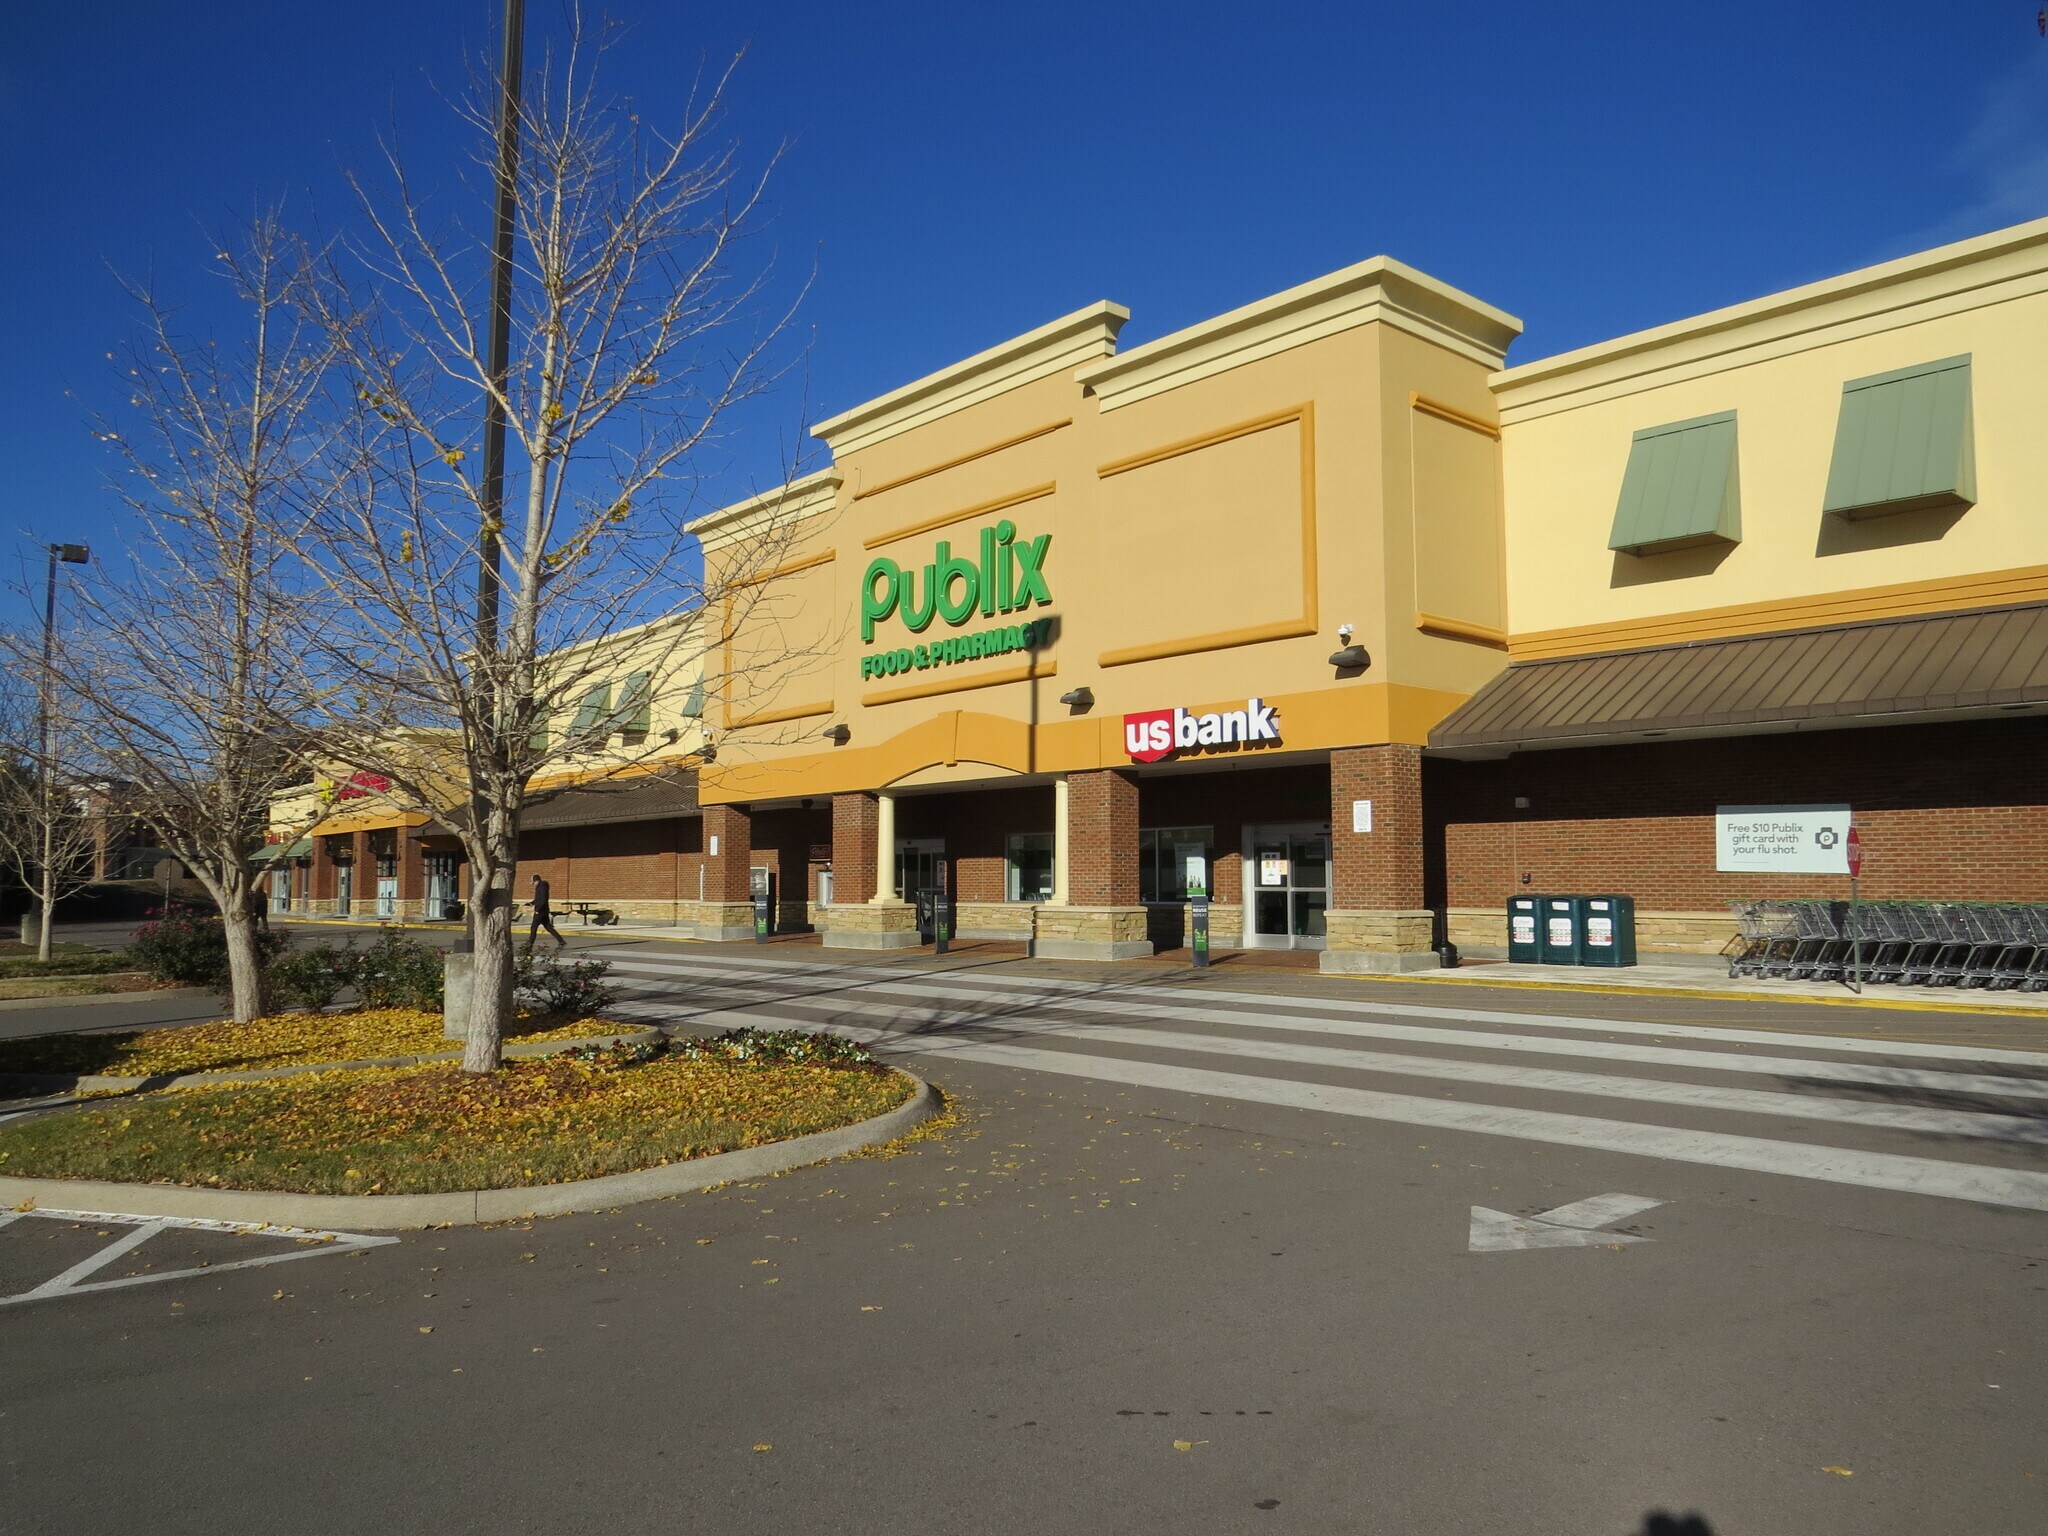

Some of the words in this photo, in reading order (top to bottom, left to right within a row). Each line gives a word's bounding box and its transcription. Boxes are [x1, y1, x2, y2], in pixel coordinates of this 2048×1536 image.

[861, 648, 914, 679] FOOD
[913, 645, 931, 668] &
[930, 619, 1053, 665] PHARMACY
[1727, 823, 1750, 833] Free
[1752, 822, 1770, 833] $10
[1771, 822, 1804, 833] Publix
[1732, 833, 1751, 846] gift
[1752, 833, 1775, 843] card
[1776, 833, 1799, 843] with
[1732, 846, 1756, 856] your
[1757, 844, 1771, 854] flu
[1772, 844, 1798, 854] shot.
